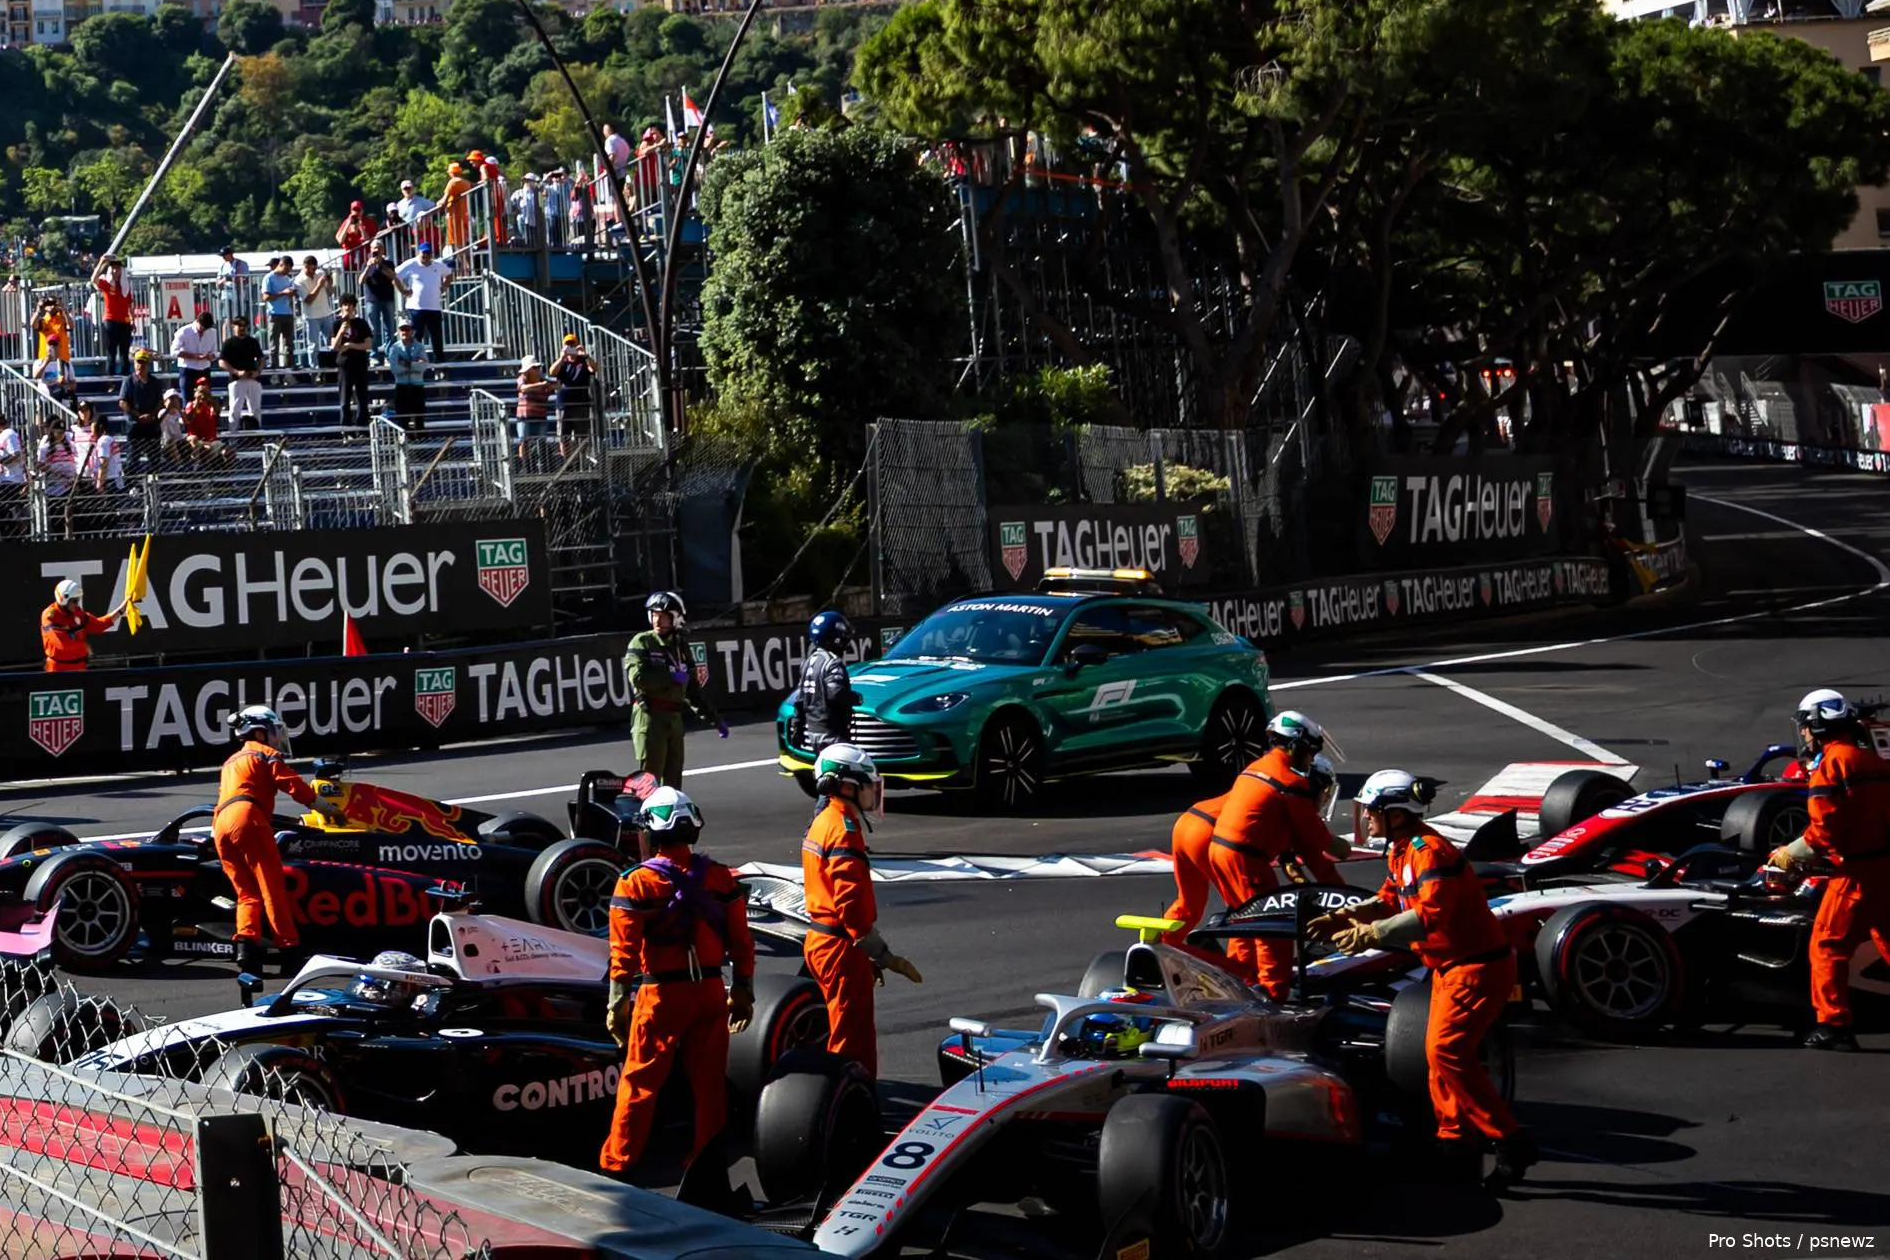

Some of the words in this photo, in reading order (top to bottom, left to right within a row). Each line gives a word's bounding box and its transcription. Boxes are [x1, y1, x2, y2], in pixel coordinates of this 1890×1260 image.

[1828, 283, 1877, 297] TAG
[167, 295, 183, 319] A
[1828, 300, 1879, 320] HEUER
[1373, 481, 1395, 502] TAG
[1406, 474, 1532, 544] TAGHeuer
[1002, 526, 1024, 544] TAG
[1178, 519, 1197, 537] TAG
[480, 543, 524, 566] TAG
[480, 569, 526, 603] HEUER
[947, 603, 995, 613] ASTON
[995, 603, 1054, 617] MARTIN
[1307, 585, 1381, 627] TAGHeuer
[1207, 599, 1285, 638] AGHeuer
[716, 636, 872, 693] TAGHer
[418, 671, 452, 691] TAG
[468, 654, 631, 723] TAGHeu
[34, 693, 80, 716] TAG
[417, 694, 455, 723] HEUER
[32, 719, 82, 754] HEUER
[378, 843, 483, 862] movento
[174, 941, 234, 954] BLINKER
[492, 1062, 623, 1111] CONTRO
[908, 1128, 955, 1139] VOLITO
[882, 1142, 935, 1170] 8
[855, 1189, 896, 1199] PIRELLI
[839, 1210, 878, 1222] TGR
